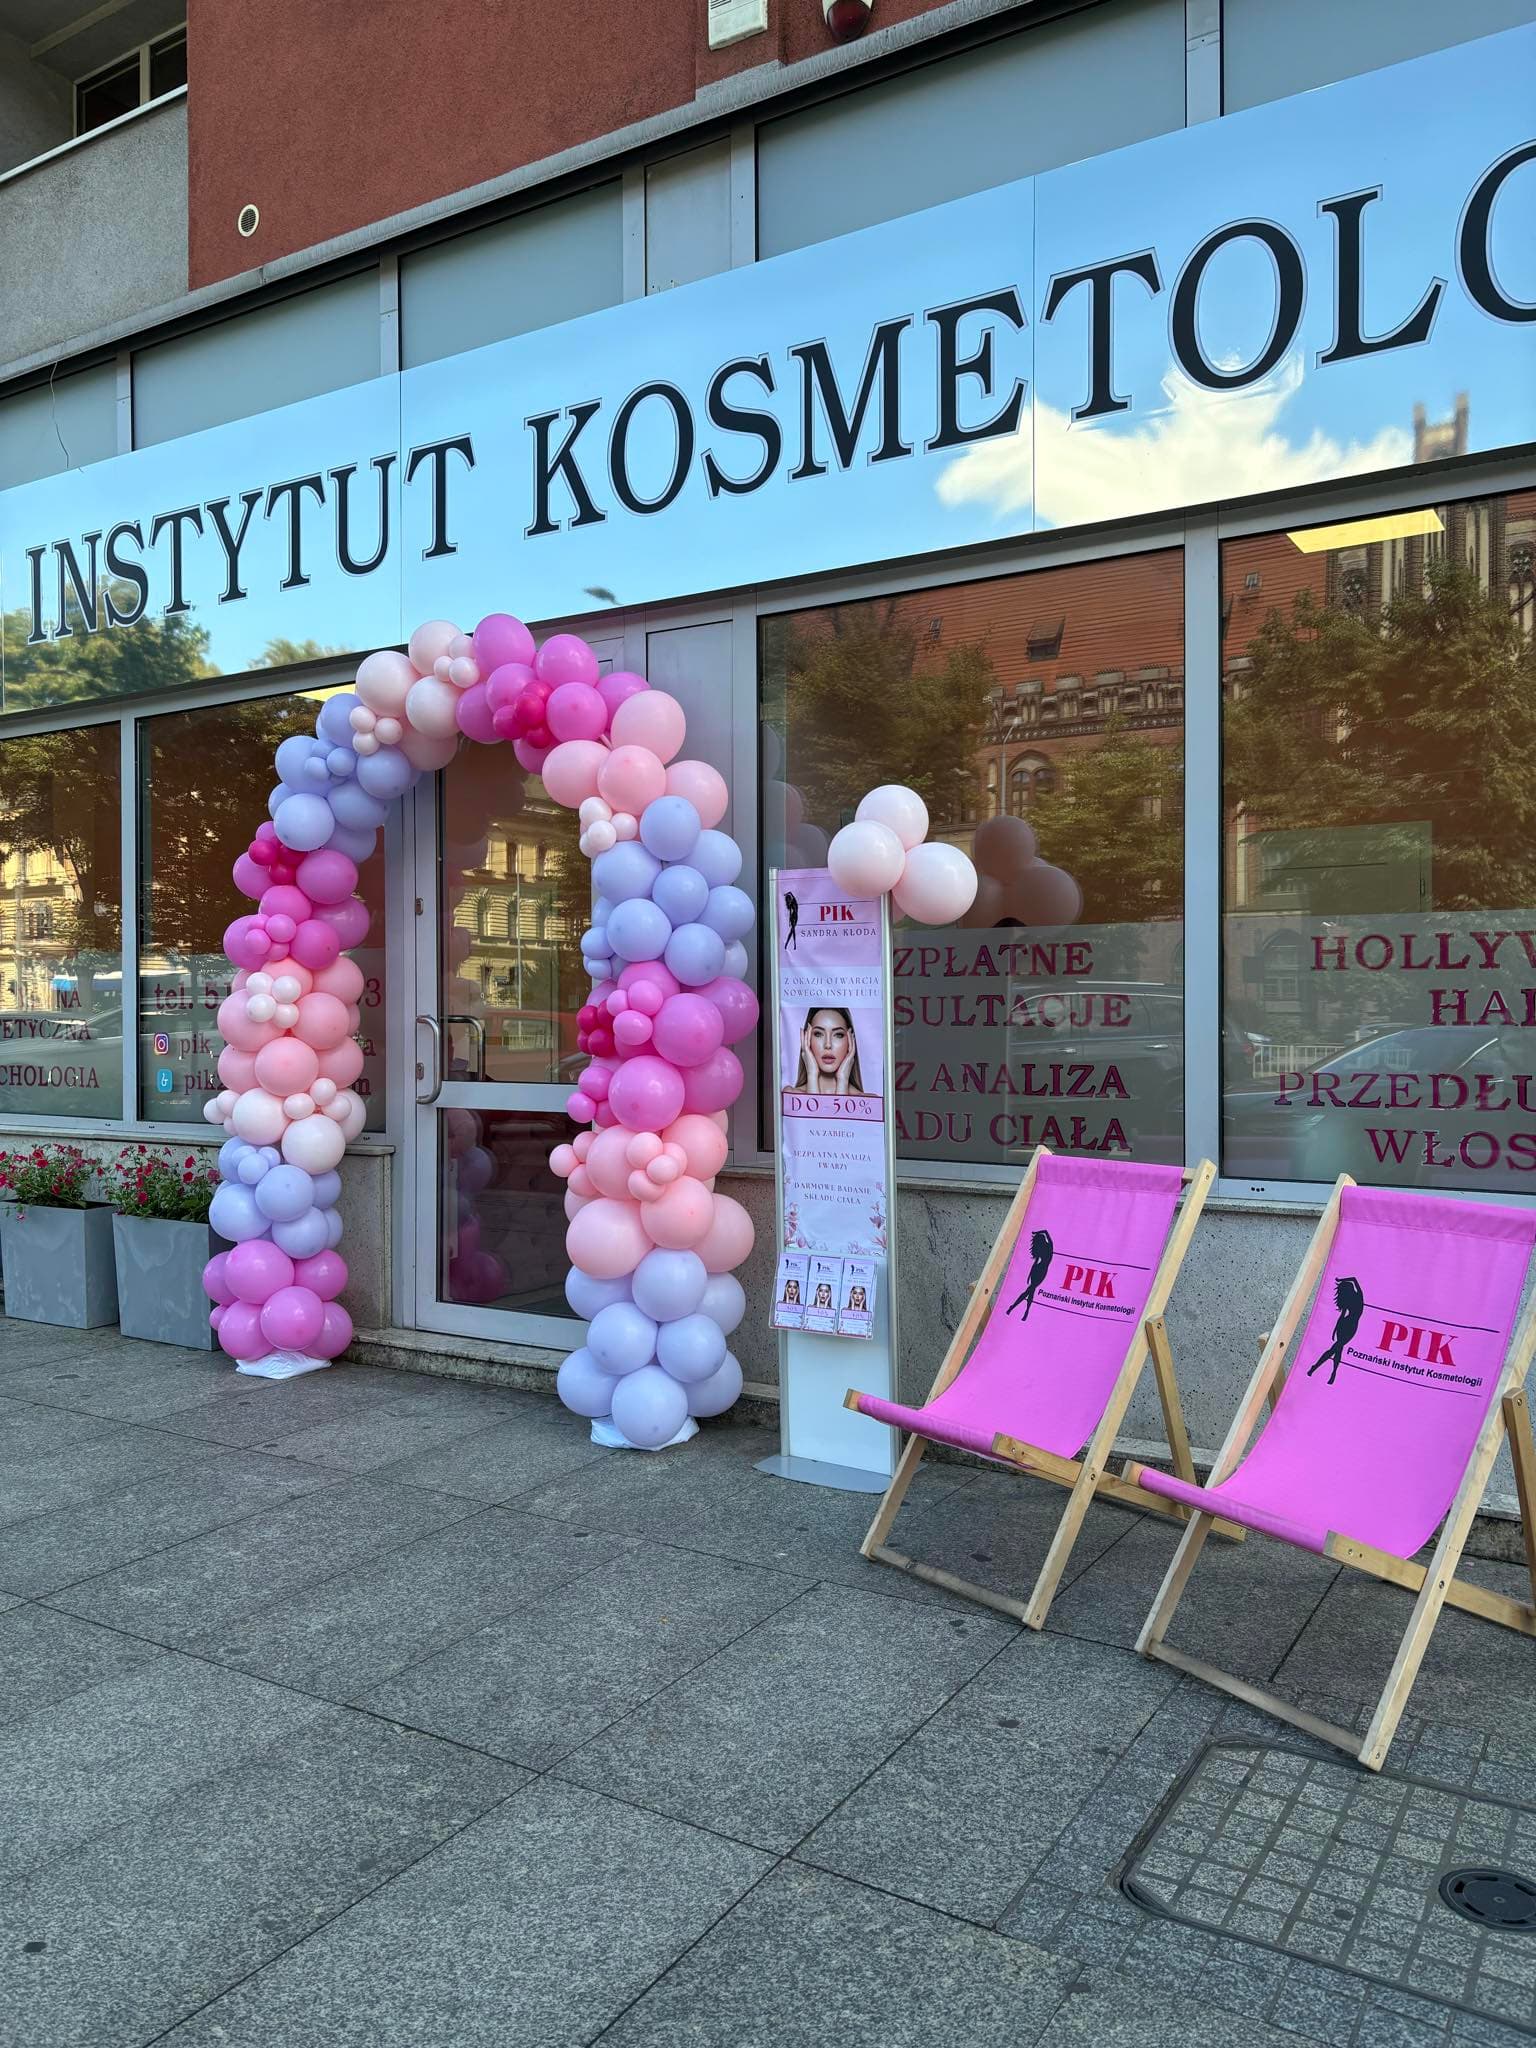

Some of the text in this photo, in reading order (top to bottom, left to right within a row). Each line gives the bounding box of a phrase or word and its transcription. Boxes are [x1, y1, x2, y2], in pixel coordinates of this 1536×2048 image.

[26, 433, 476, 645] INSTYTUT
[820, 905, 855, 921] PIK
[801, 929, 838, 937] SANDRA
[154, 982, 194, 1009] tel.
[0, 1018, 91, 1040] ETYCZNA
[929, 1063, 1130, 1098] ANALIZA
[791, 1097, 819, 1112] DO
[989, 1113, 1133, 1152] CIAŁA
[1365, 1128, 1536, 1170] WŁOS
[1060, 1264, 1117, 1298] PIK
[1376, 1320, 1458, 1366] PIK
[1346, 1347, 1482, 1387] Poznański Instytut Kosmetologii
